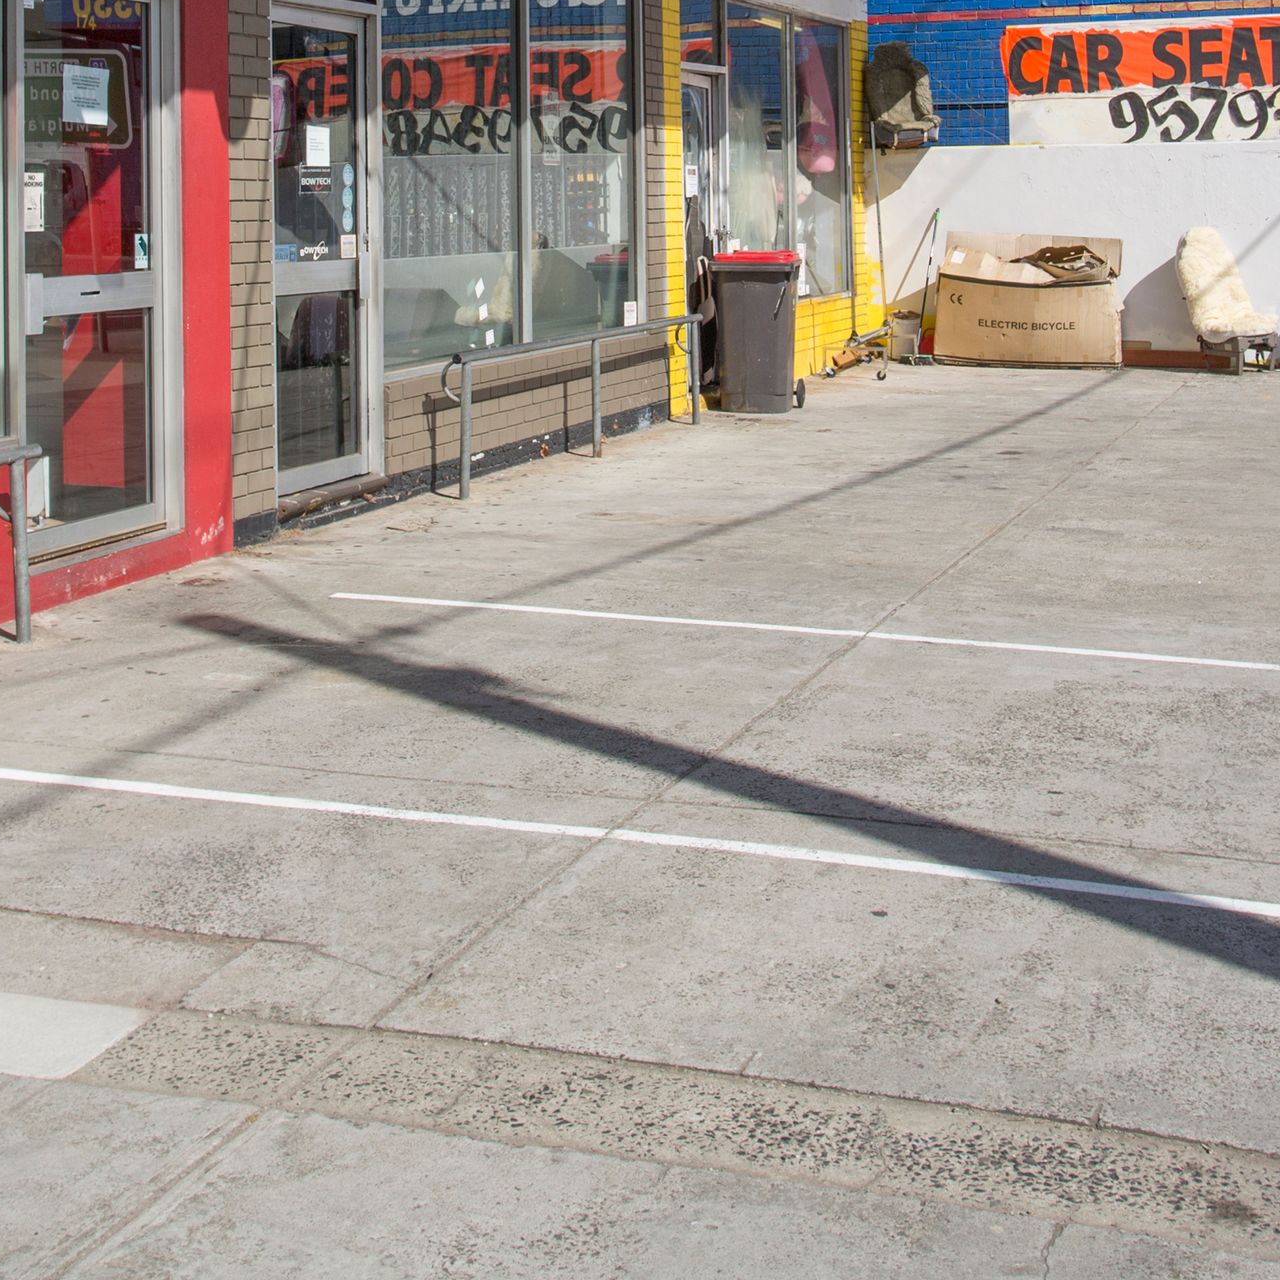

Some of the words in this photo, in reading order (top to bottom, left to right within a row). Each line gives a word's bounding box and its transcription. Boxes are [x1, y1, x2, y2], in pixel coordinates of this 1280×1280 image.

[76, 15, 97, 31] 174
[1007, 33, 1127, 96] CAR
[301, 177, 332, 186] BOWTECH
[300, 244, 329, 258] BOWTECH
[978, 318, 1029, 331] ELECTRIC
[1031, 321, 1076, 331] BICYCLE
